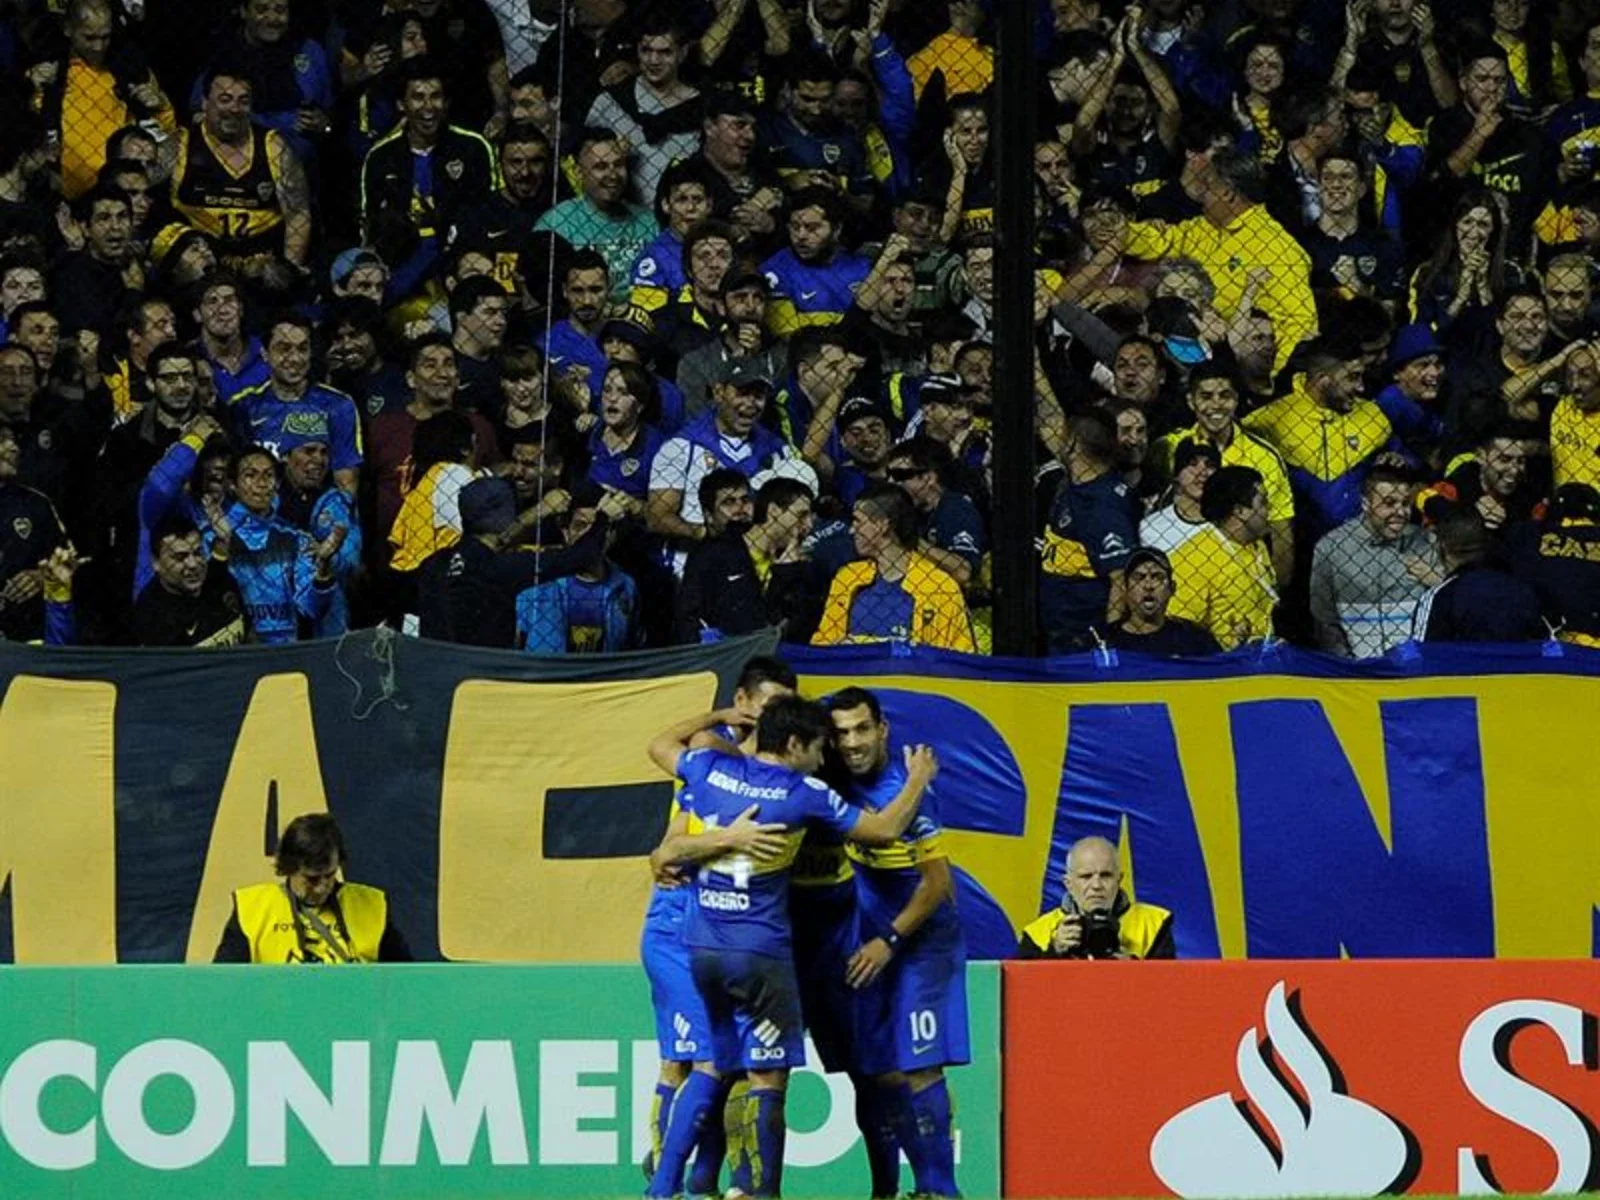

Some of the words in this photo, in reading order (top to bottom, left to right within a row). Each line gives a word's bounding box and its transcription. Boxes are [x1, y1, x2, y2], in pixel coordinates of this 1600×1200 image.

[218, 214, 250, 238] 12
[909, 1009, 938, 1041] 10
[750, 1046, 786, 1061] EXO
[0, 1038, 960, 1171] CONMEO
